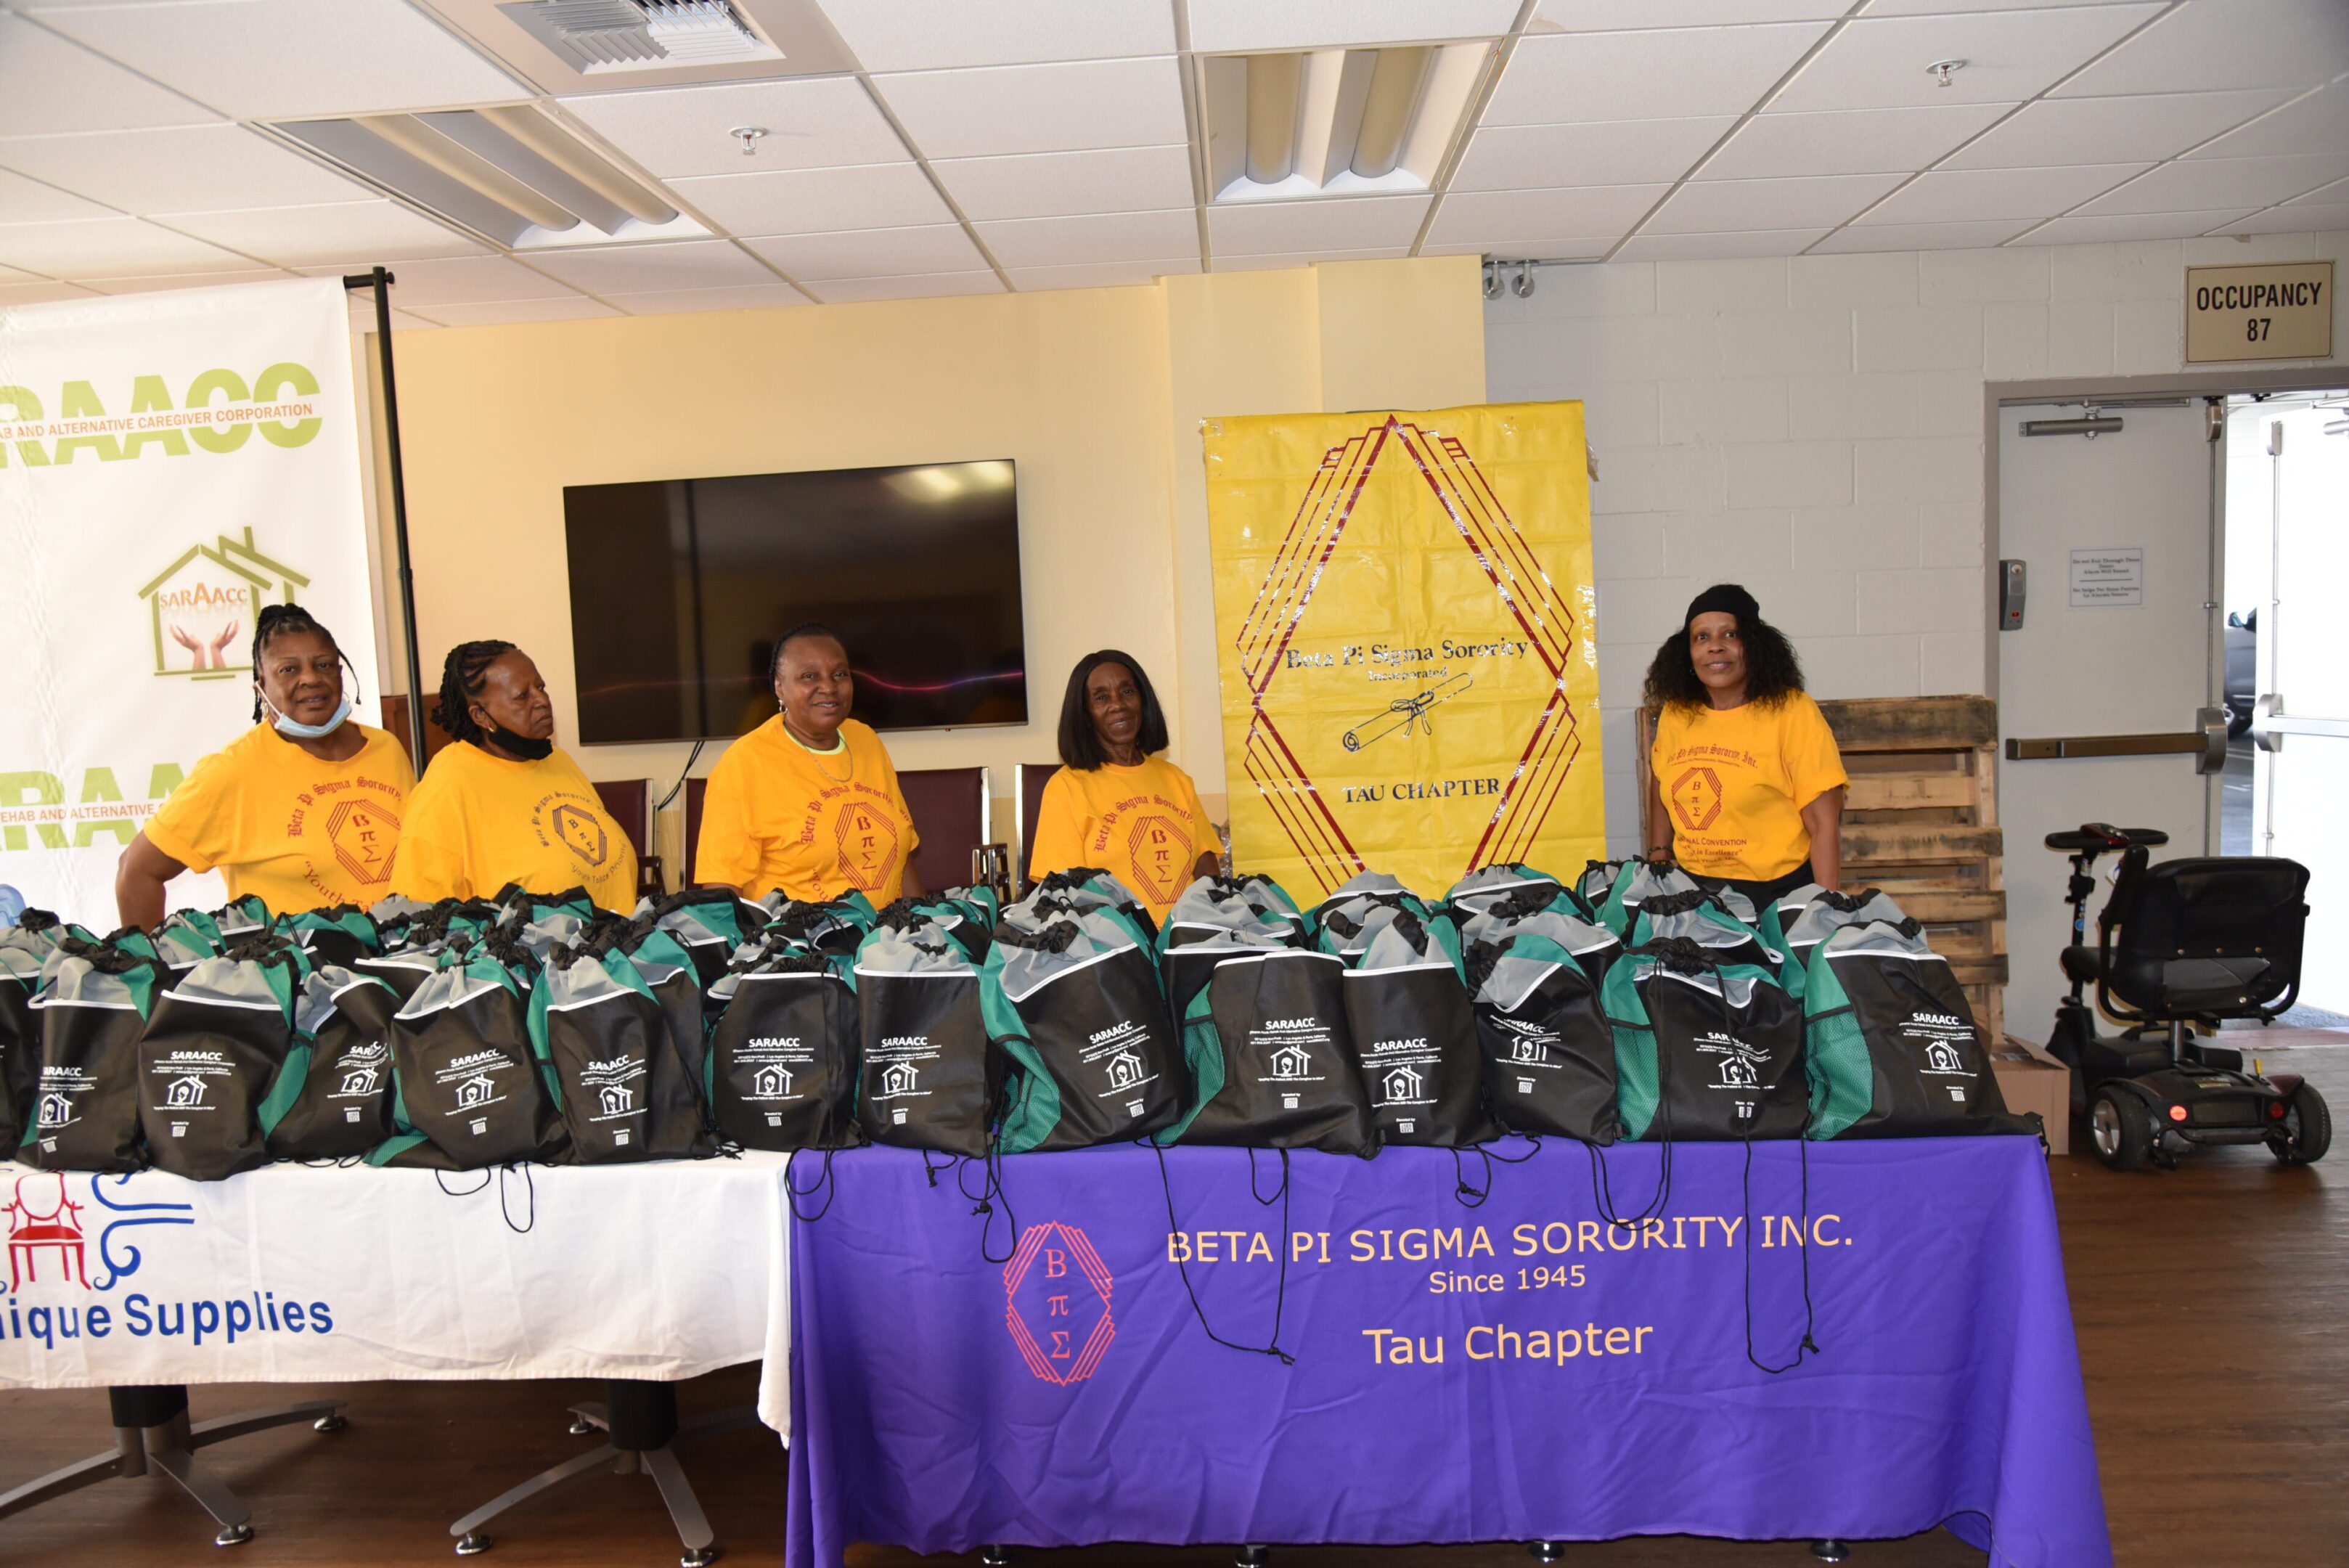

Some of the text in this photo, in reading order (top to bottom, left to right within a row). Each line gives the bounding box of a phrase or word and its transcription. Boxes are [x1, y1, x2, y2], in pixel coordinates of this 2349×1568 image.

[2197, 282, 2322, 311] OCCUPANCY
[2247, 318, 2271, 342] 87
[17, 425, 44, 438] AND
[49, 419, 134, 436] ALTERNATIVE
[138, 412, 211, 428] CAREGIVER
[216, 404, 313, 422] CORPORATION
[1286, 637, 1529, 669] Beta Pi Sigma Sorority
[1368, 665, 1447, 683] Incorporated
[820, 785, 851, 799] Sigma
[1341, 777, 1501, 803] TAU CHAPTER
[40, 808, 66, 821] AND
[70, 804, 155, 820] ALTERNATIVE
[287, 808, 306, 838] Beta
[297, 793, 314, 807] Pi
[313, 780, 351, 796] Sigma
[807, 800, 823, 813] Pi
[801, 816, 817, 845] Beta
[1094, 825, 1111, 854] Beta
[1103, 809, 1118, 825] Pi
[1116, 796, 1149, 813] Sigma
[1701, 837, 1747, 846] CONVENTION
[1265, 1017, 1315, 1030] SARAACC
[1913, 1013, 1959, 1026] SARAACC
[748, 1037, 800, 1048] SARAACC
[881, 1037, 928, 1048] SARAACC
[1089, 1020, 1133, 1044] SARAACC
[171, 1050, 223, 1061] SARAACC
[1373, 1038, 1427, 1052] SARAACC
[1168, 1214, 1853, 1263] BETA PI SIGMA SORORITY INC.
[1429, 1264, 1587, 1294] Since 1945
[0, 1291, 334, 1349] ique Supplies
[1362, 1322, 1654, 1367] Tau Chapter
